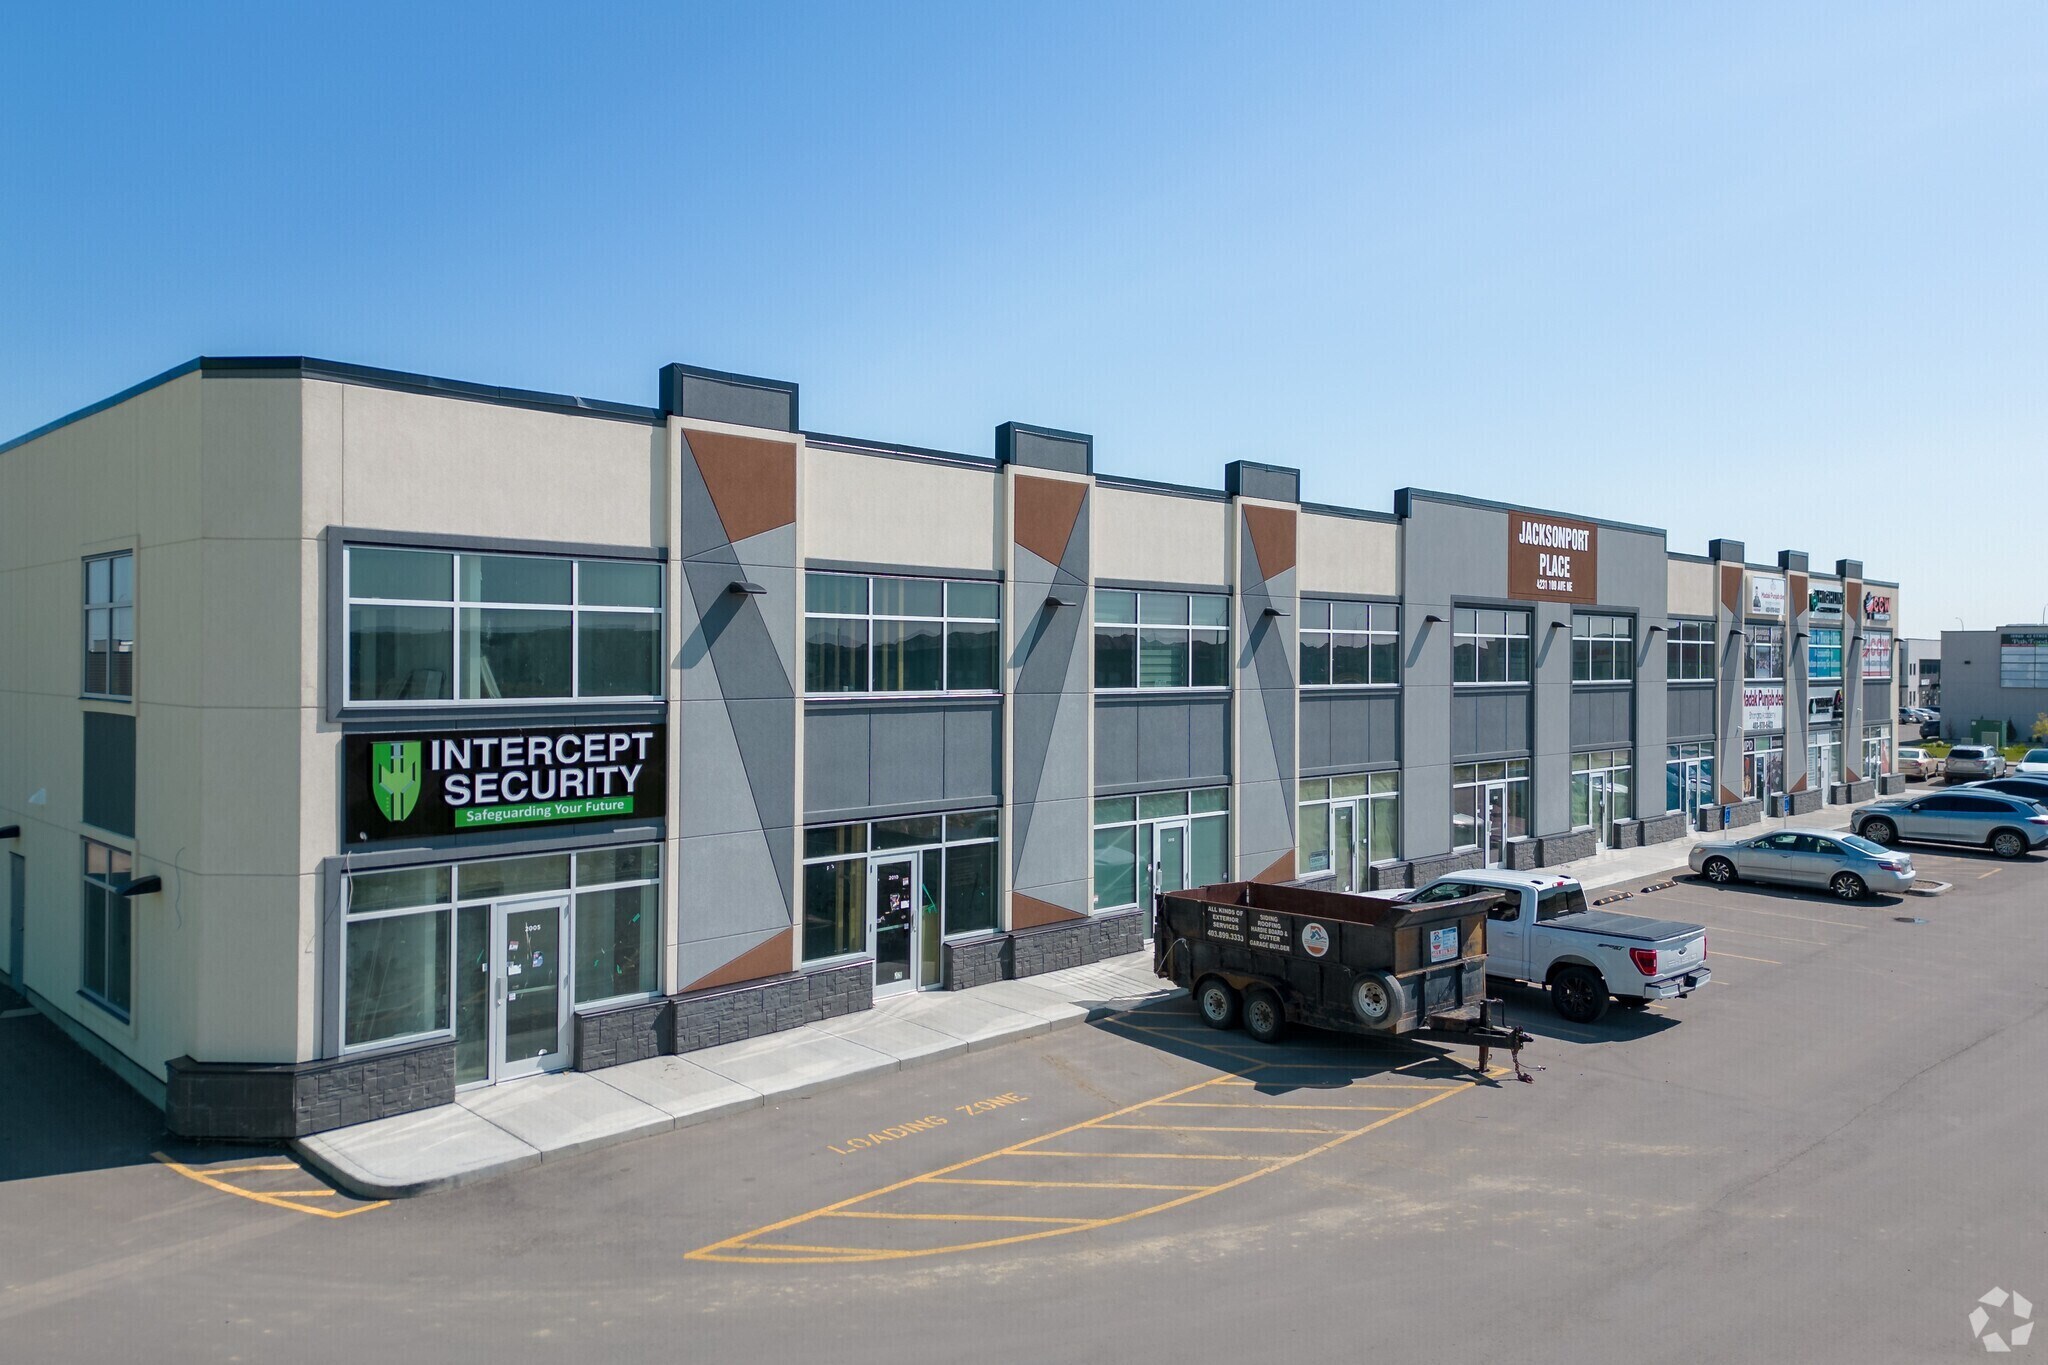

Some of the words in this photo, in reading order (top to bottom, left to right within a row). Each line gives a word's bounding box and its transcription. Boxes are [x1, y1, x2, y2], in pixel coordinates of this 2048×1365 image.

[1519, 521, 1589, 551] JACKSONPORT
[1539, 553, 1570, 578] PLACE
[1557, 581, 1566, 591] AVE
[1566, 581, 1573, 592] NE
[1818, 590, 1844, 604] HIGHLIN
[431, 732, 653, 770] INTERCEPT
[444, 764, 643, 805] SECURITY
[466, 806, 552, 823] Safeguarding
[554, 802, 582, 815] Your
[585, 799, 625, 812] Future
[1212, 914, 1239, 923] EXTERIOR
[1260, 914, 1278, 922] SIDING
[525, 924, 541, 932] 2005
[1213, 921, 1239, 931] SERVICES
[1250, 925, 1268, 934] HARDIE
[1268, 928, 1283, 936] BOARD
[1257, 920, 1281, 929] ROOFING
[1258, 933, 1281, 942] GUTTER
[1249, 939, 1269, 949] GARAGE
[1269, 942, 1290, 952] BUILDER
[827, 1115, 948, 1155] LOADING
[955, 1092, 1028, 1116] ZONE
